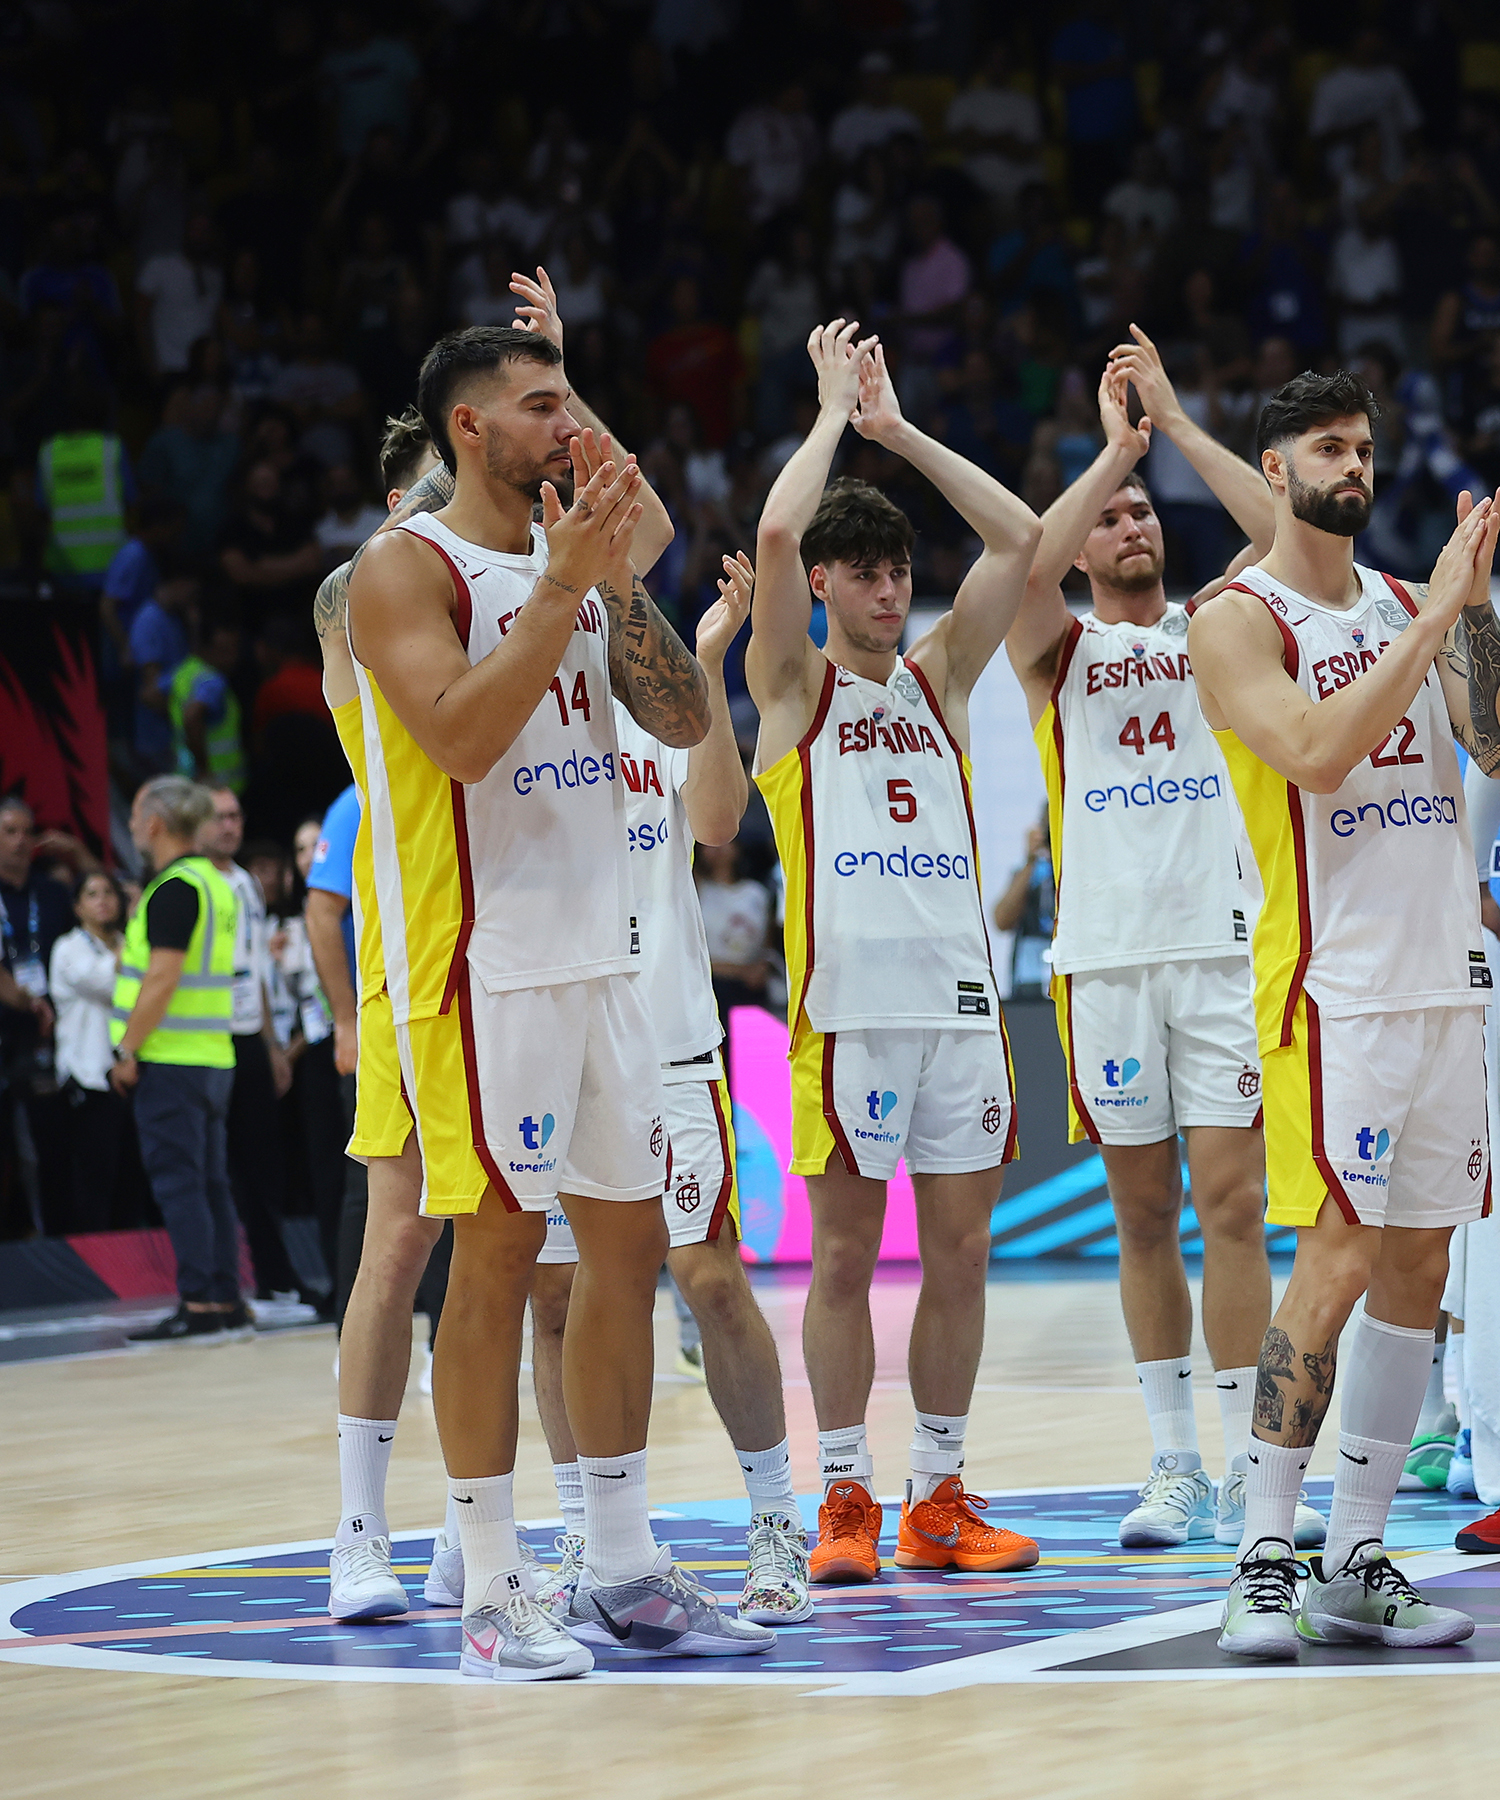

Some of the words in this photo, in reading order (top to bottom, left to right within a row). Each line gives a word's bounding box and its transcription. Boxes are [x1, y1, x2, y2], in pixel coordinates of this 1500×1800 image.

[549, 670, 591, 727] 14
[1118, 711, 1176, 756] 44
[1368, 716, 1424, 769] 22
[886, 779, 918, 824] 5
[1085, 774, 1222, 813] endesa
[1330, 788, 1458, 838] endesa
[834, 845, 970, 880] endesa
